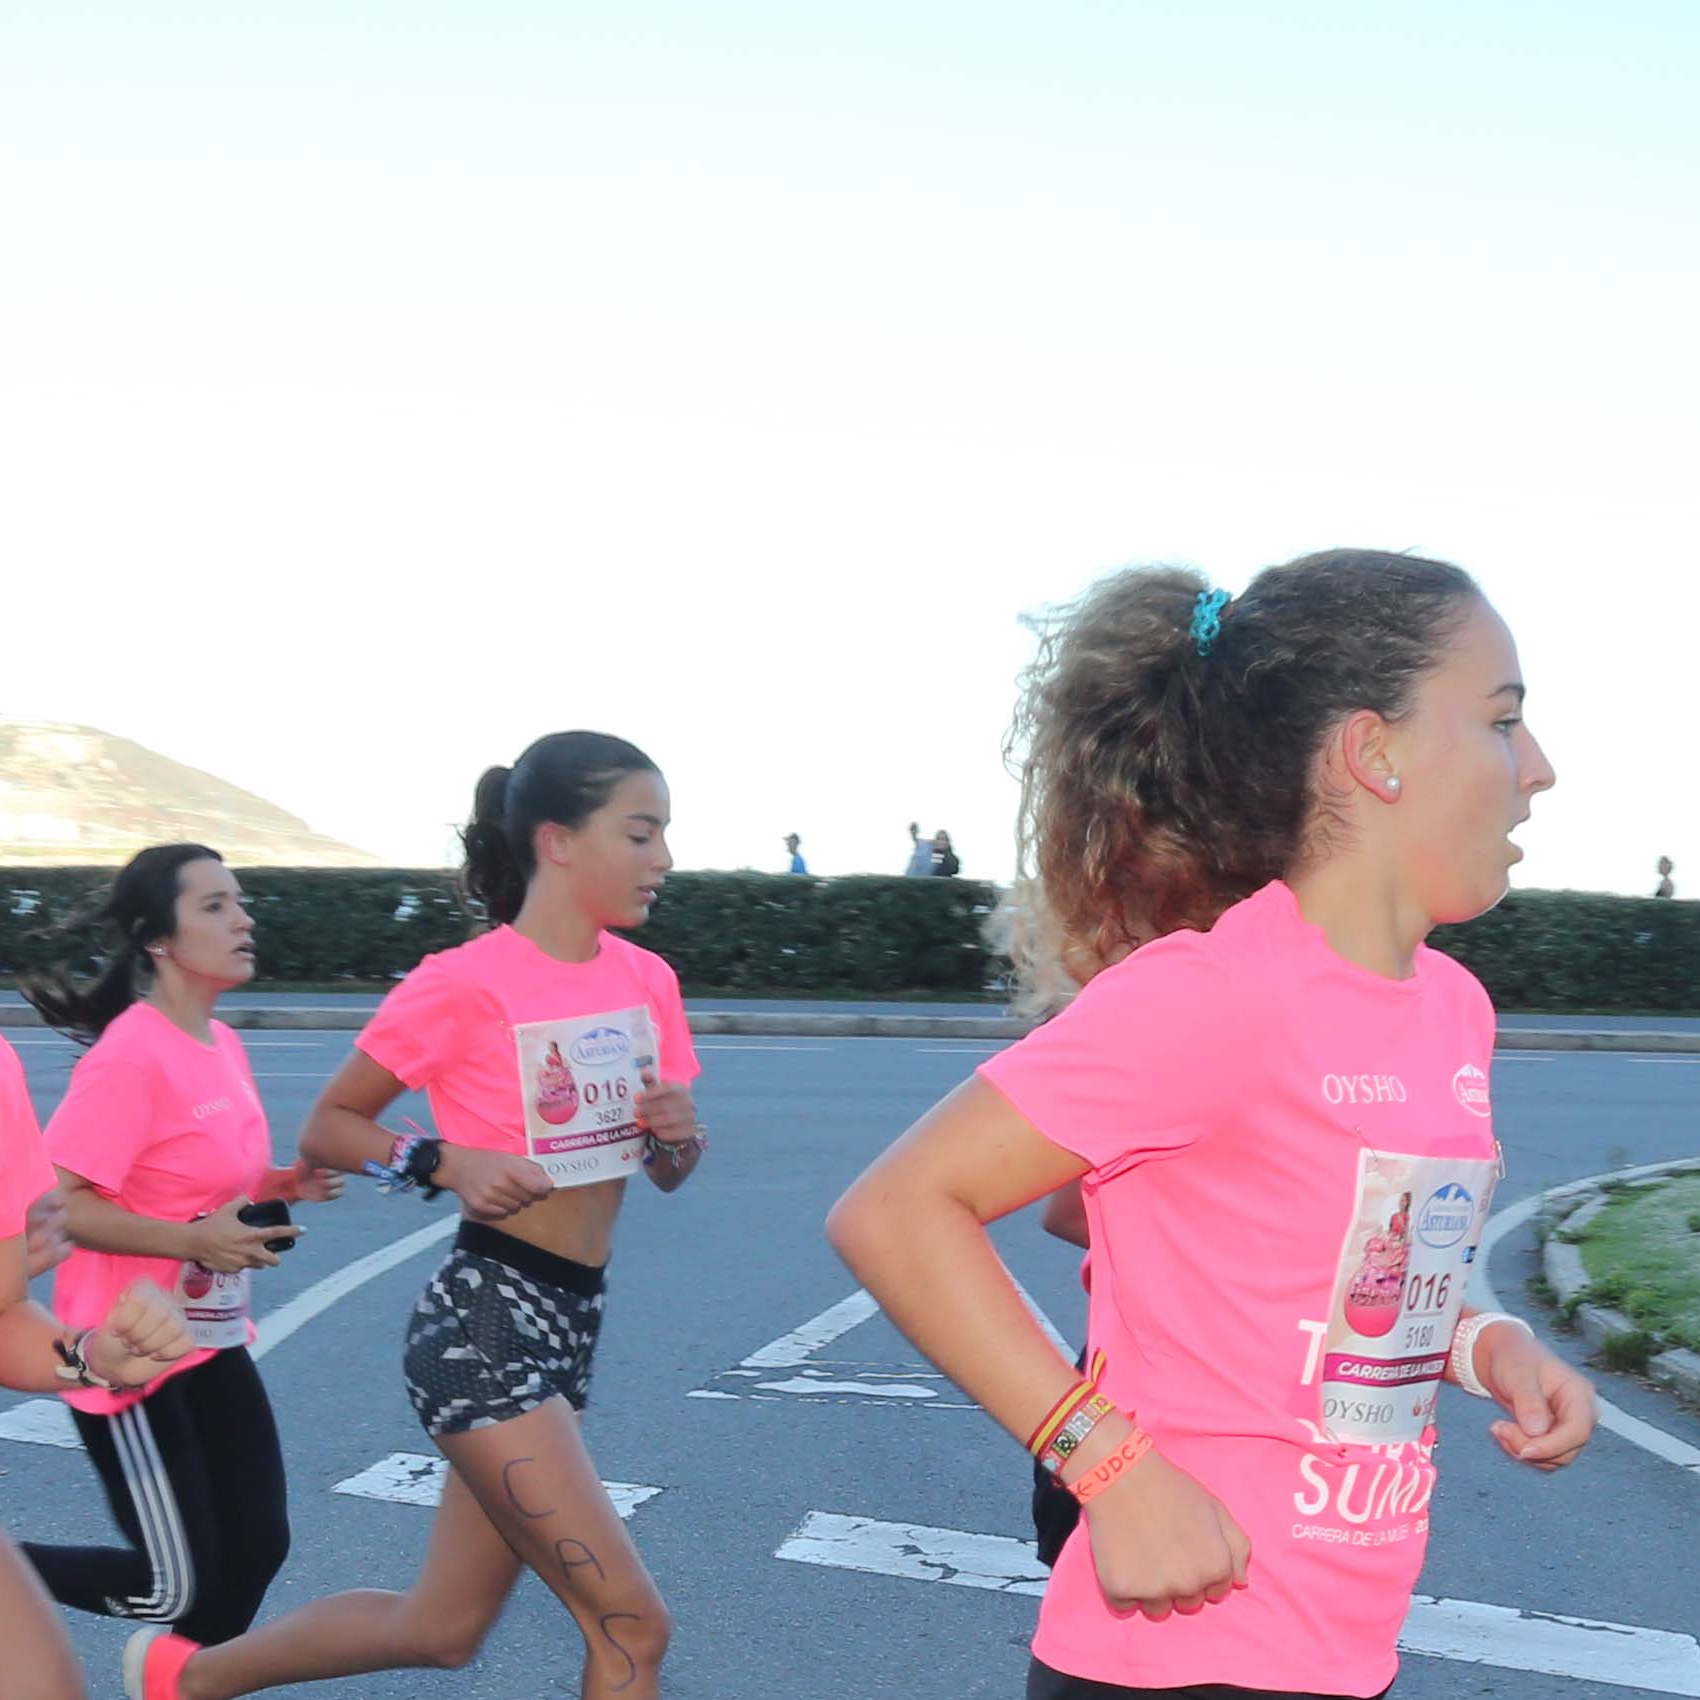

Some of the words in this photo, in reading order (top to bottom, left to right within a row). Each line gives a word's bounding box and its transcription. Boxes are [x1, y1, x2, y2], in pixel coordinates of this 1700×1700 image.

[583, 1077, 628, 1104] 016
[1322, 1073, 1407, 1104] OYSHO
[548, 1157, 600, 1175] OYSHO
[1406, 1273, 1452, 1311] 016
[1405, 1326, 1434, 1349] 5180
[1323, 1398, 1395, 1424] OYSHO
[1095, 1445, 1135, 1482] UDC
